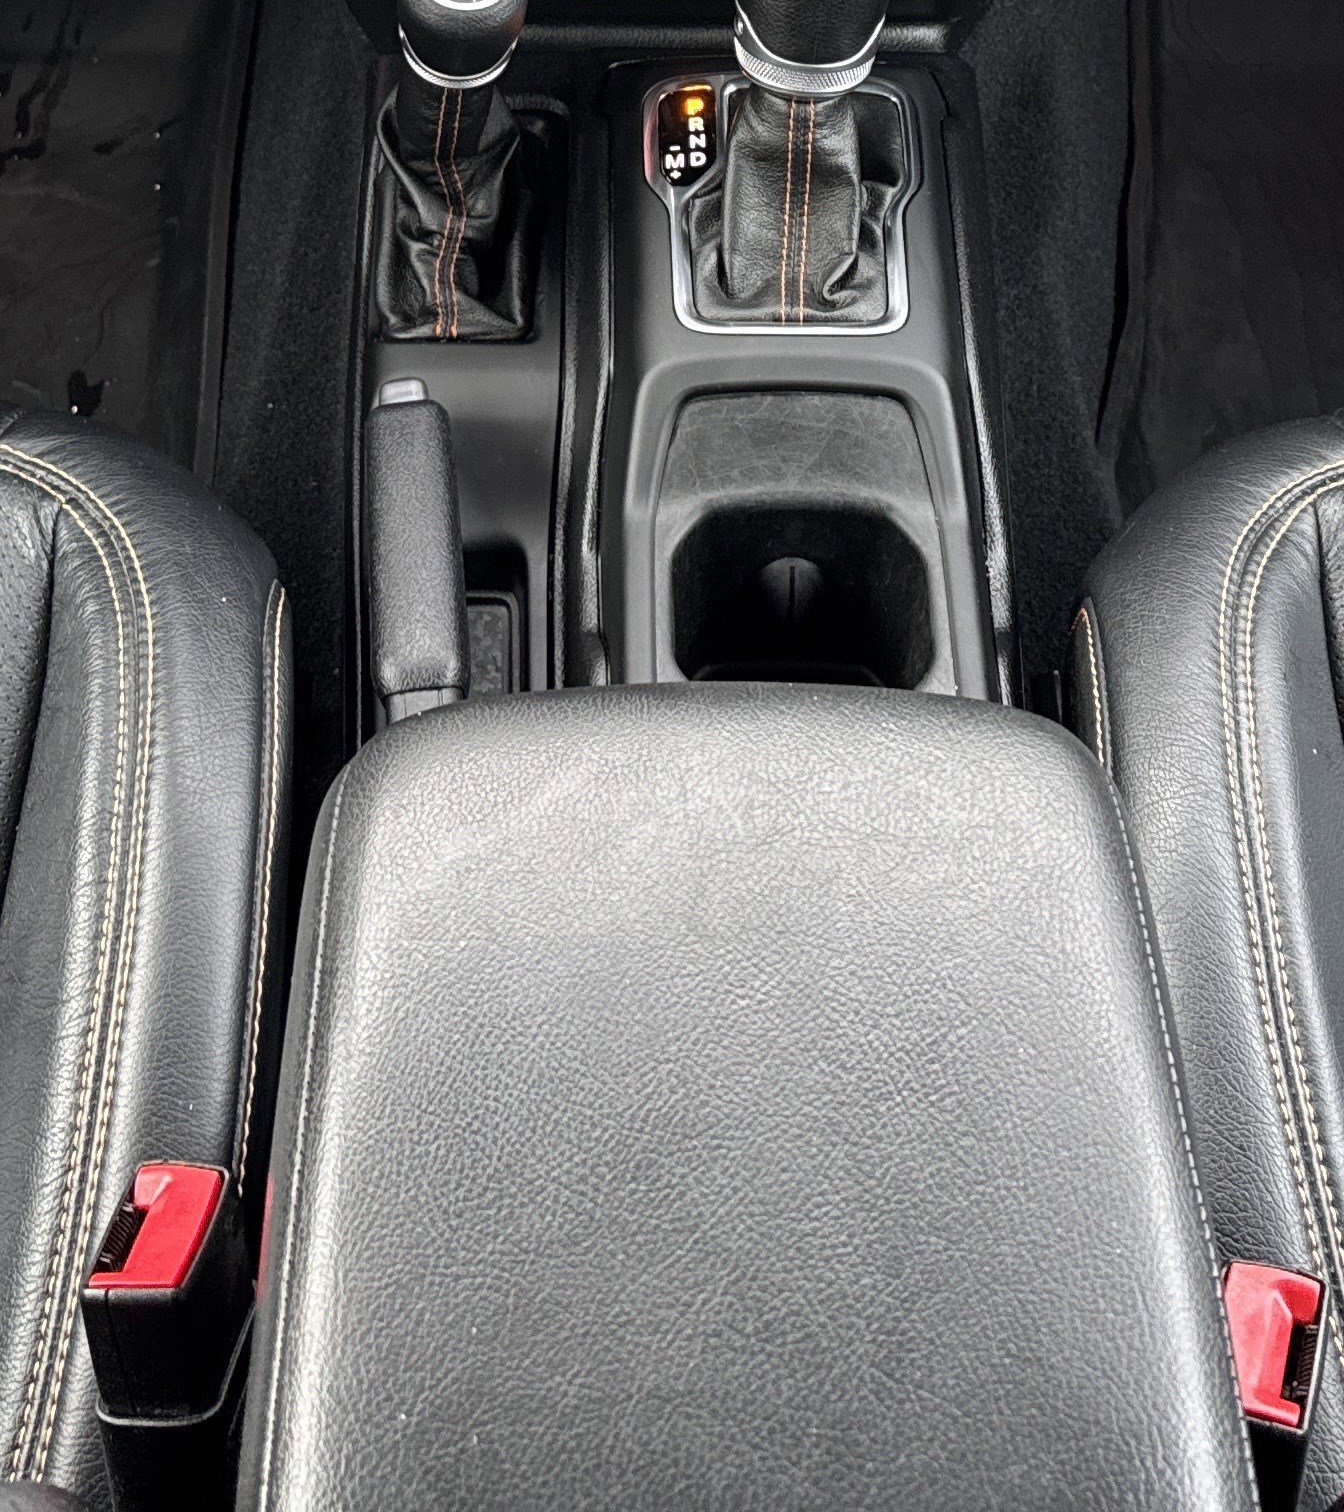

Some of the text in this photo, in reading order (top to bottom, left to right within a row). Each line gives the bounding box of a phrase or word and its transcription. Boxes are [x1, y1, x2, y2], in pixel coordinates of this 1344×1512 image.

[687, 97, 704, 115] P
[688, 116, 705, 131] R
[689, 133, 706, 149] N
[665, 153, 685, 169] M
[689, 151, 707, 167] D
